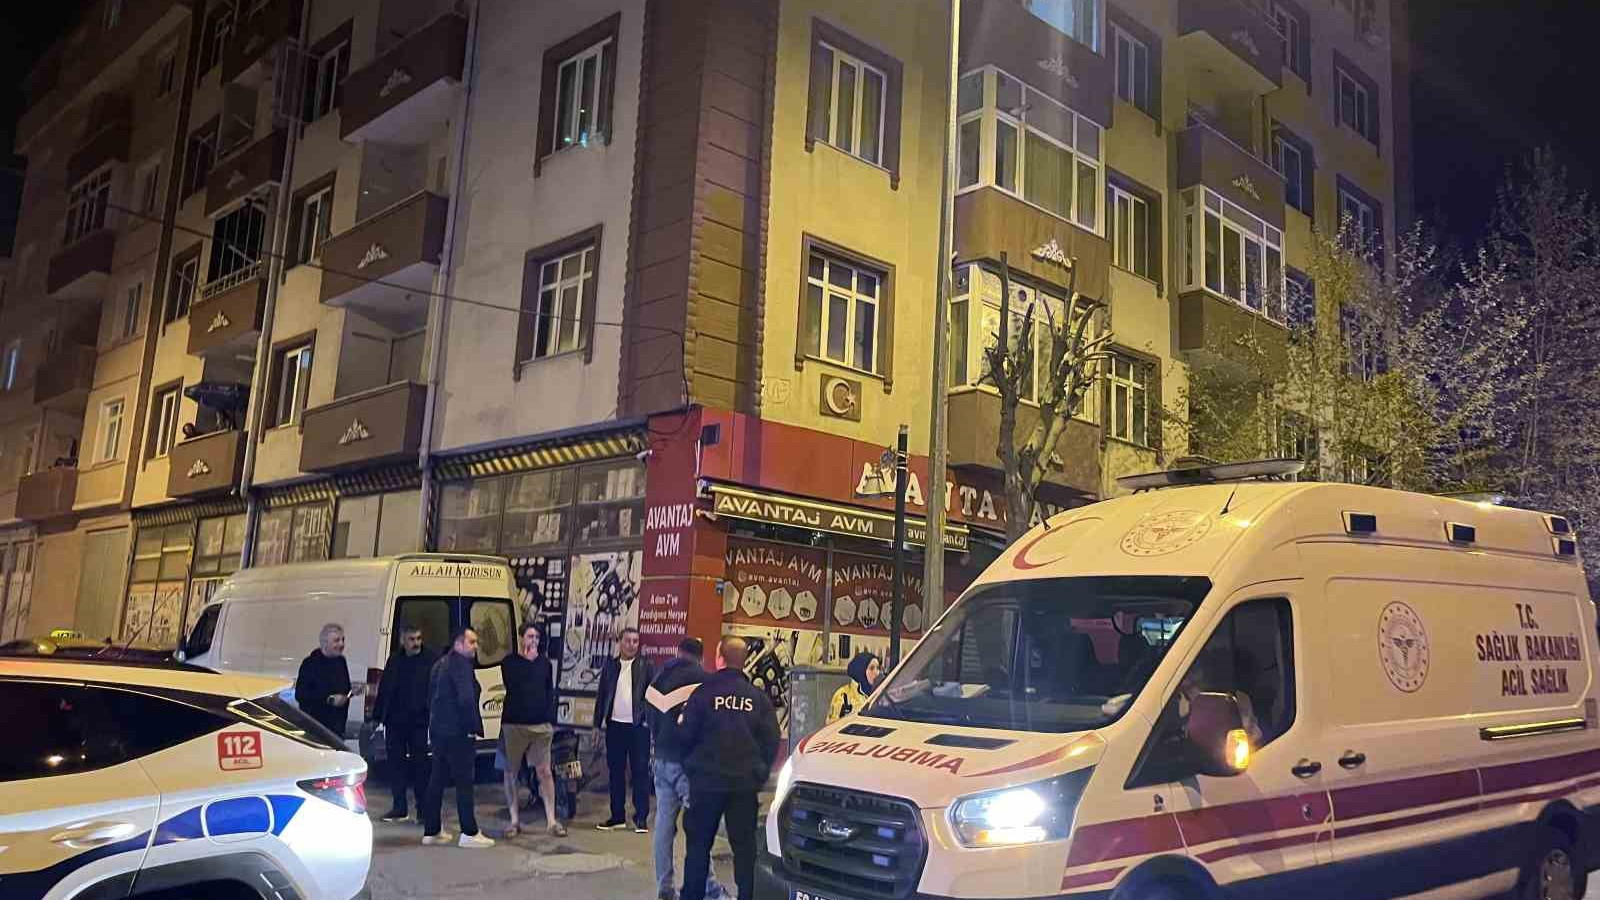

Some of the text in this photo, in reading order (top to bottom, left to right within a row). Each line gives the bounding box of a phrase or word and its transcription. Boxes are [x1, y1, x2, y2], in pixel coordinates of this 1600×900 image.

[646, 503, 694, 557] AVANTAJ AVM
[830, 514, 874, 534] AVM
[455, 565, 503, 579] KORUSUN
[725, 547, 823, 583] VANTAJ AVM
[834, 563, 894, 587] AVANTAJ
[1516, 603, 1539, 629] T.C.
[1476, 630, 1581, 661] SAĞLIK BAKANLIĞI
[1531, 665, 1569, 695] SAĞLIK
[224, 735, 257, 755] 112
